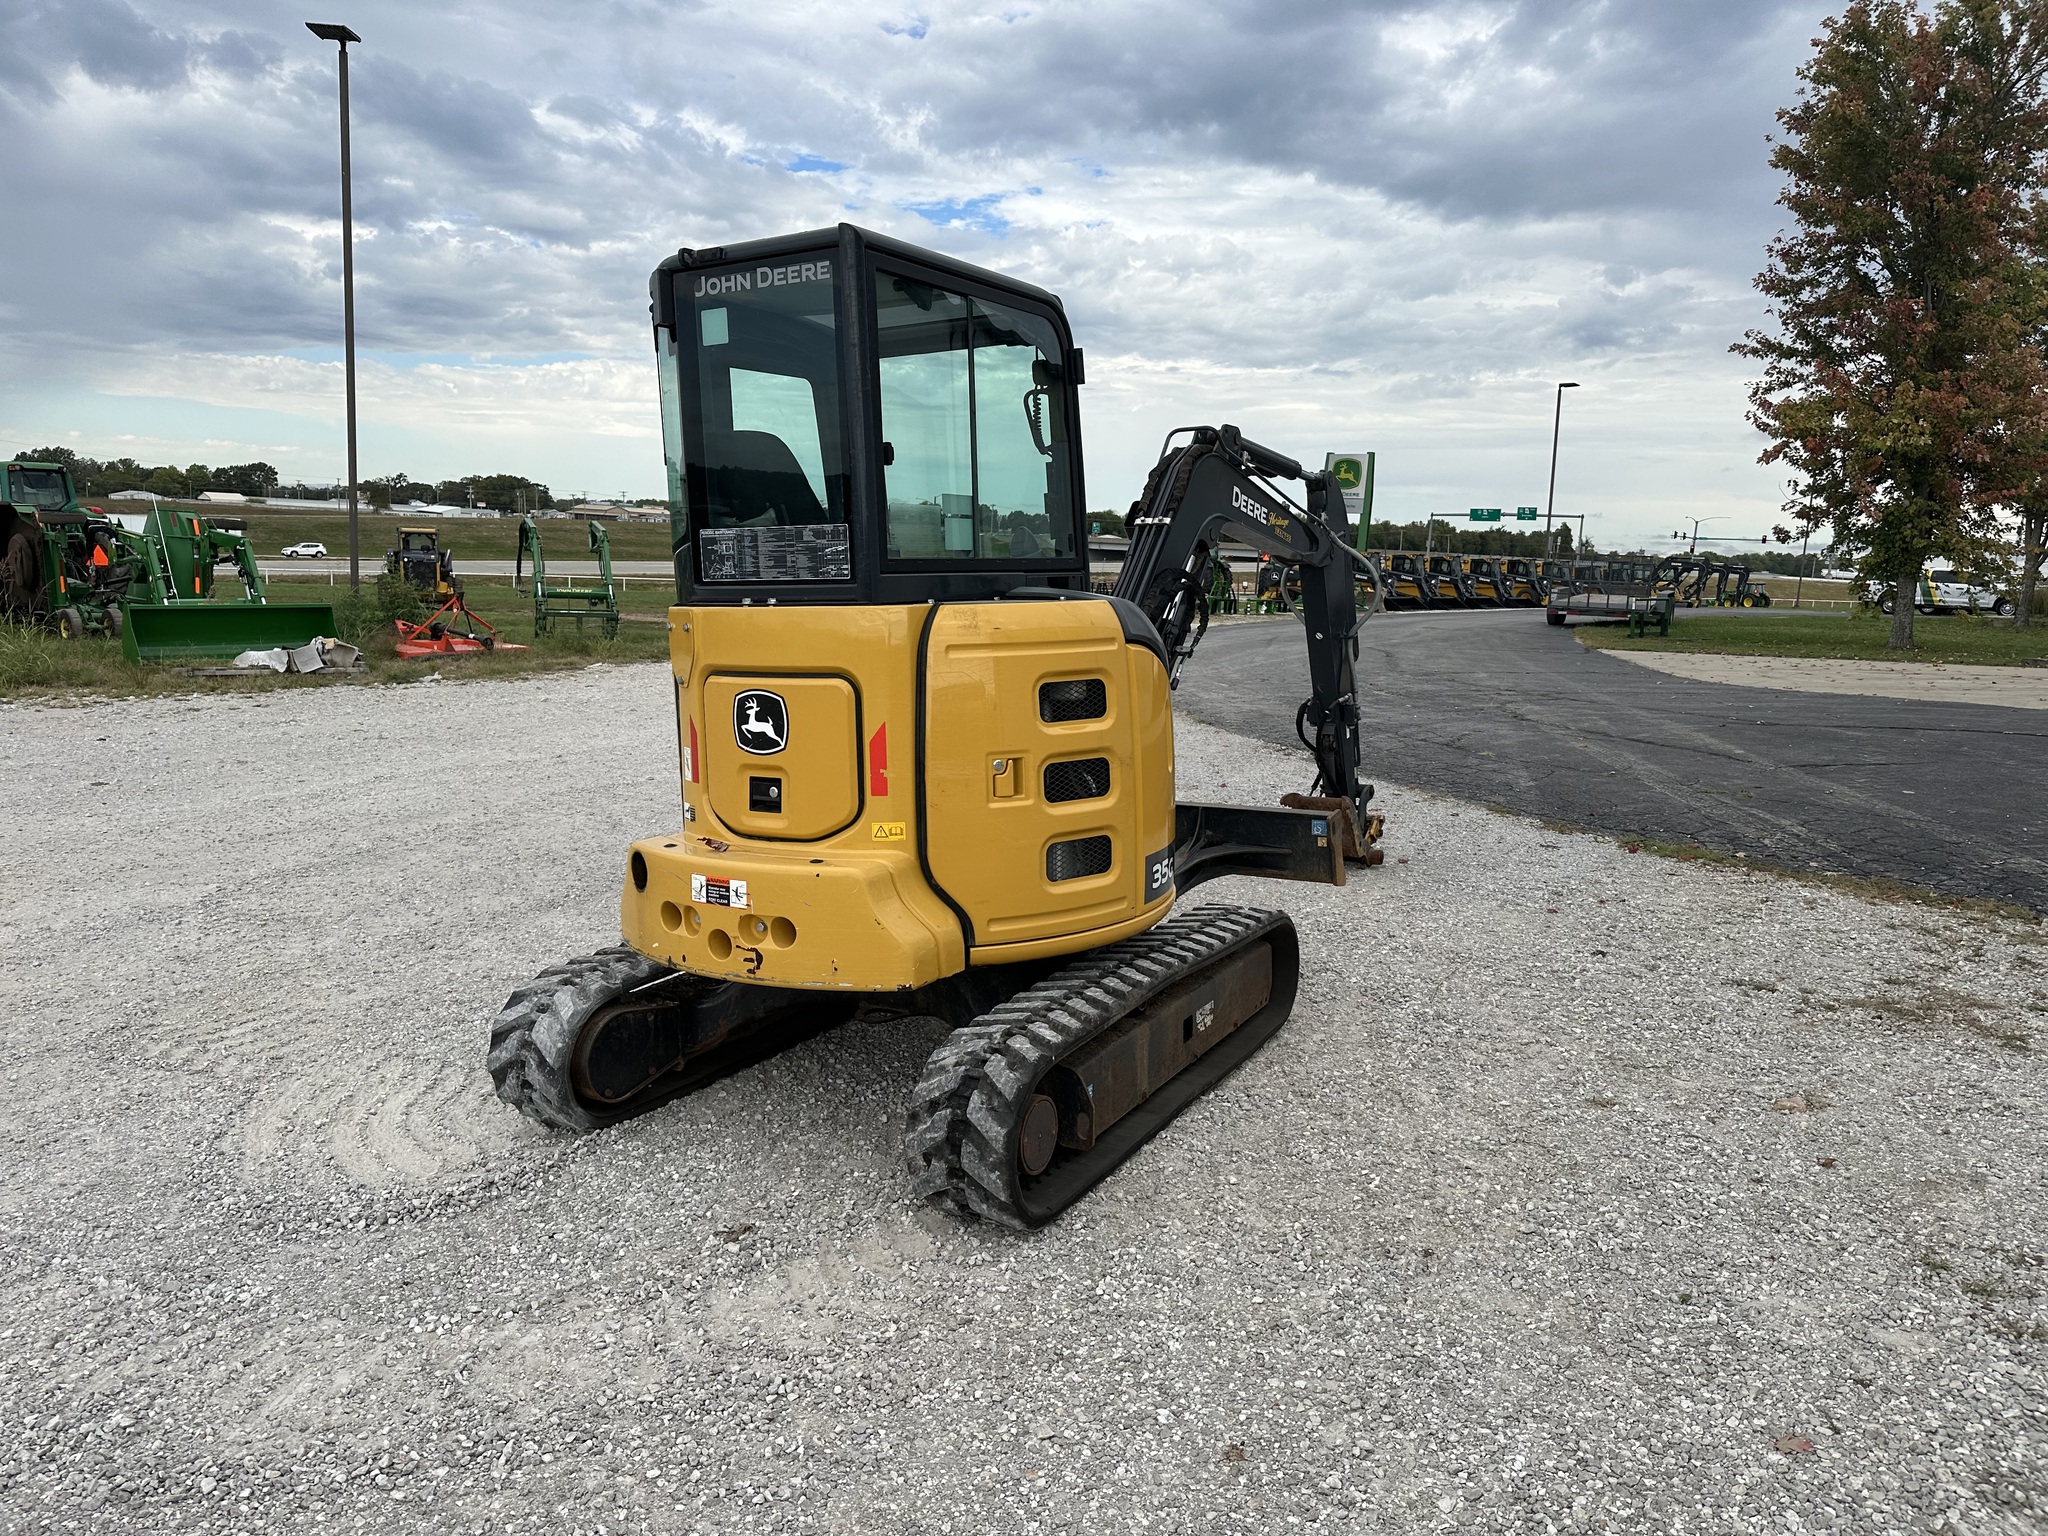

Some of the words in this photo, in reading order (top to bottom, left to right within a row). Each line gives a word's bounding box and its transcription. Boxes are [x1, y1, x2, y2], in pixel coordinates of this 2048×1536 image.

[695, 273, 751, 298] JOHN
[756, 260, 831, 289] DEERE
[1231, 485, 1269, 525] DEERE
